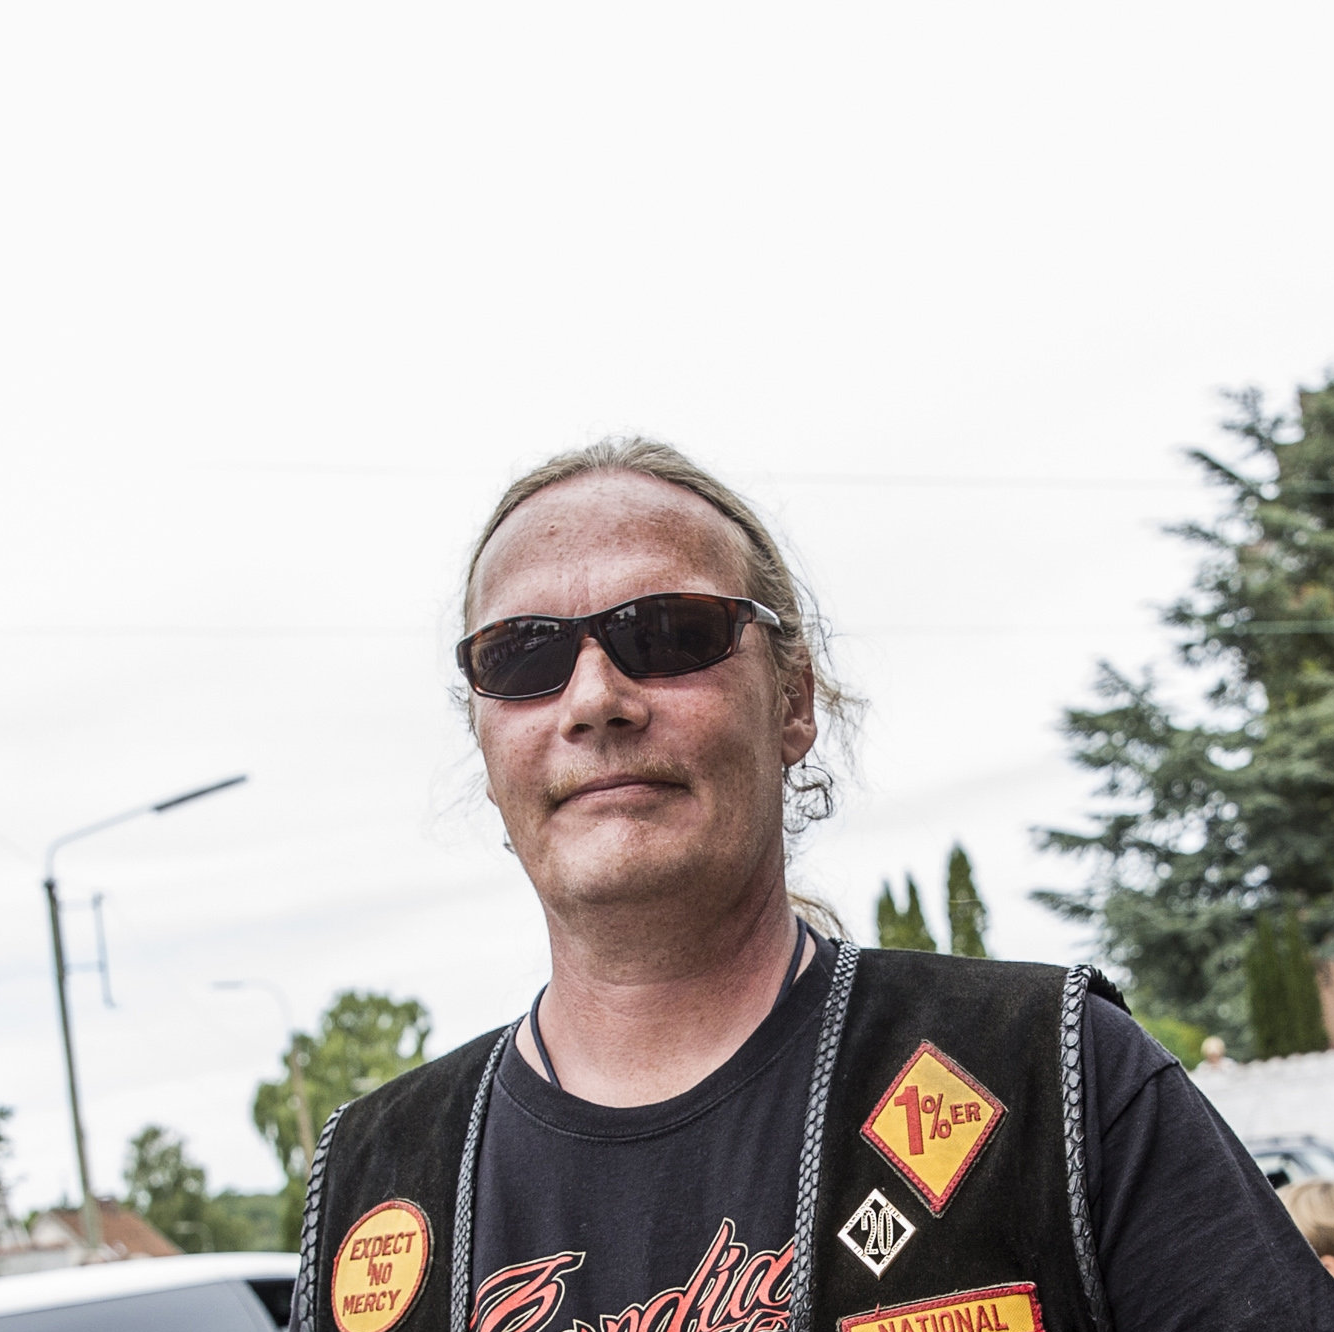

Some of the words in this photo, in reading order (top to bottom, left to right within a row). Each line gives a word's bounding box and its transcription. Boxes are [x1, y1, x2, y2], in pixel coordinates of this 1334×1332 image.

[893, 1085, 981, 1156] 1%ER
[861, 1206, 893, 1255] 20
[350, 1231, 418, 1276] EXPECT
[369, 1261, 393, 1287] NO
[342, 1289, 402, 1317] MERCY
